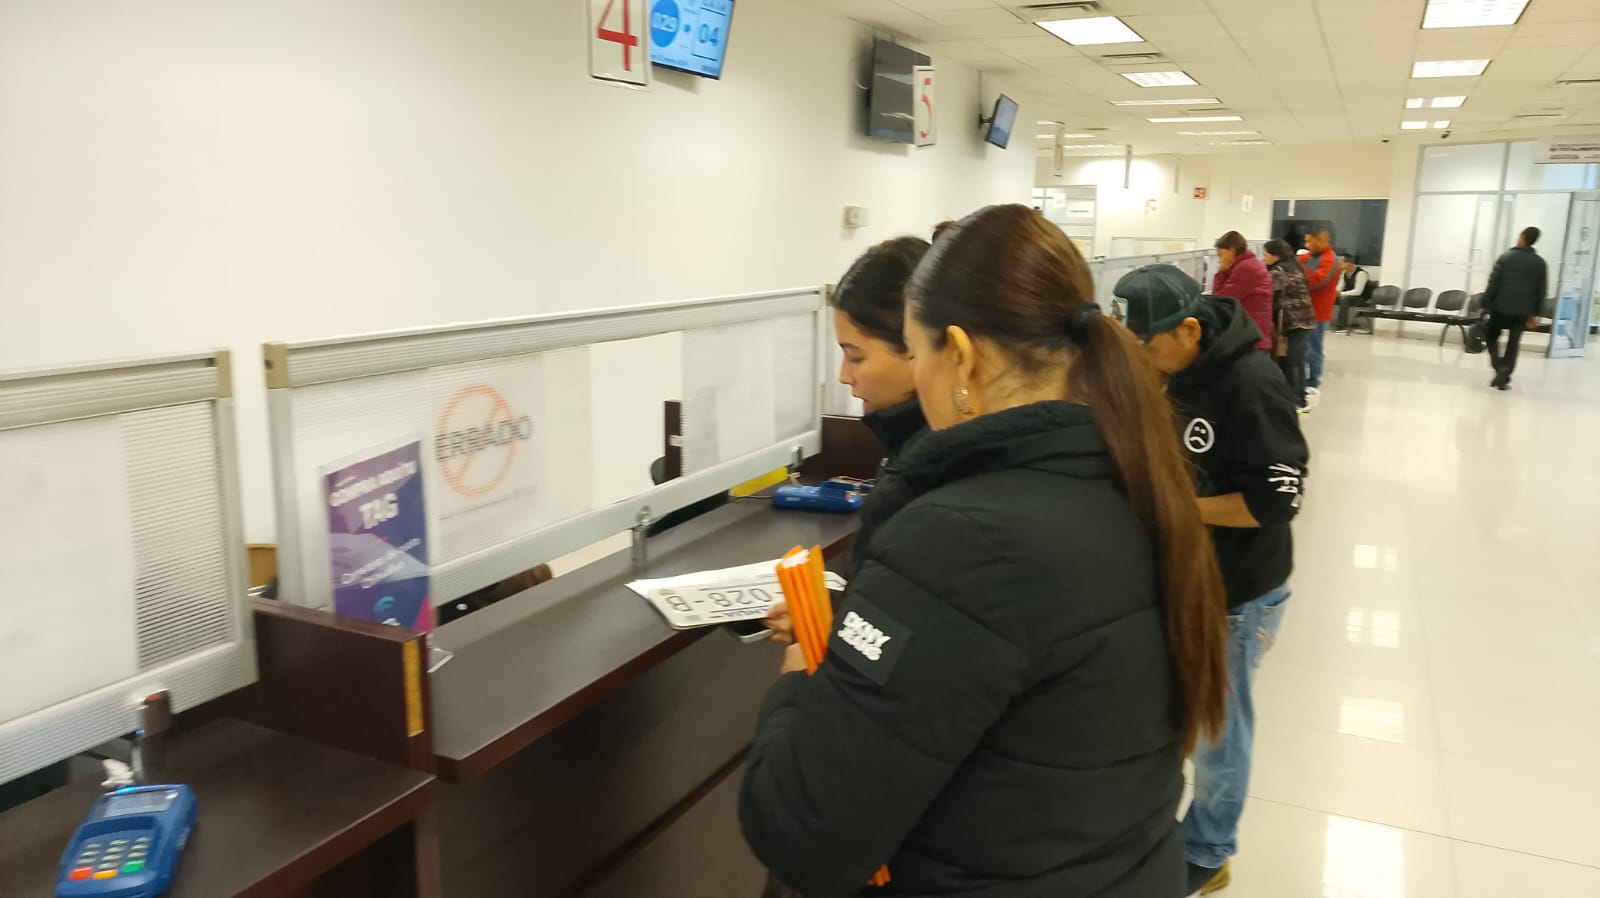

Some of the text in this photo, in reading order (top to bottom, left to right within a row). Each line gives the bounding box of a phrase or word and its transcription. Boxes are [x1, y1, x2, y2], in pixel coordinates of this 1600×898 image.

[597, 0, 638, 71] 4
[700, 23, 720, 47] 04
[358, 493, 399, 529] TAG
